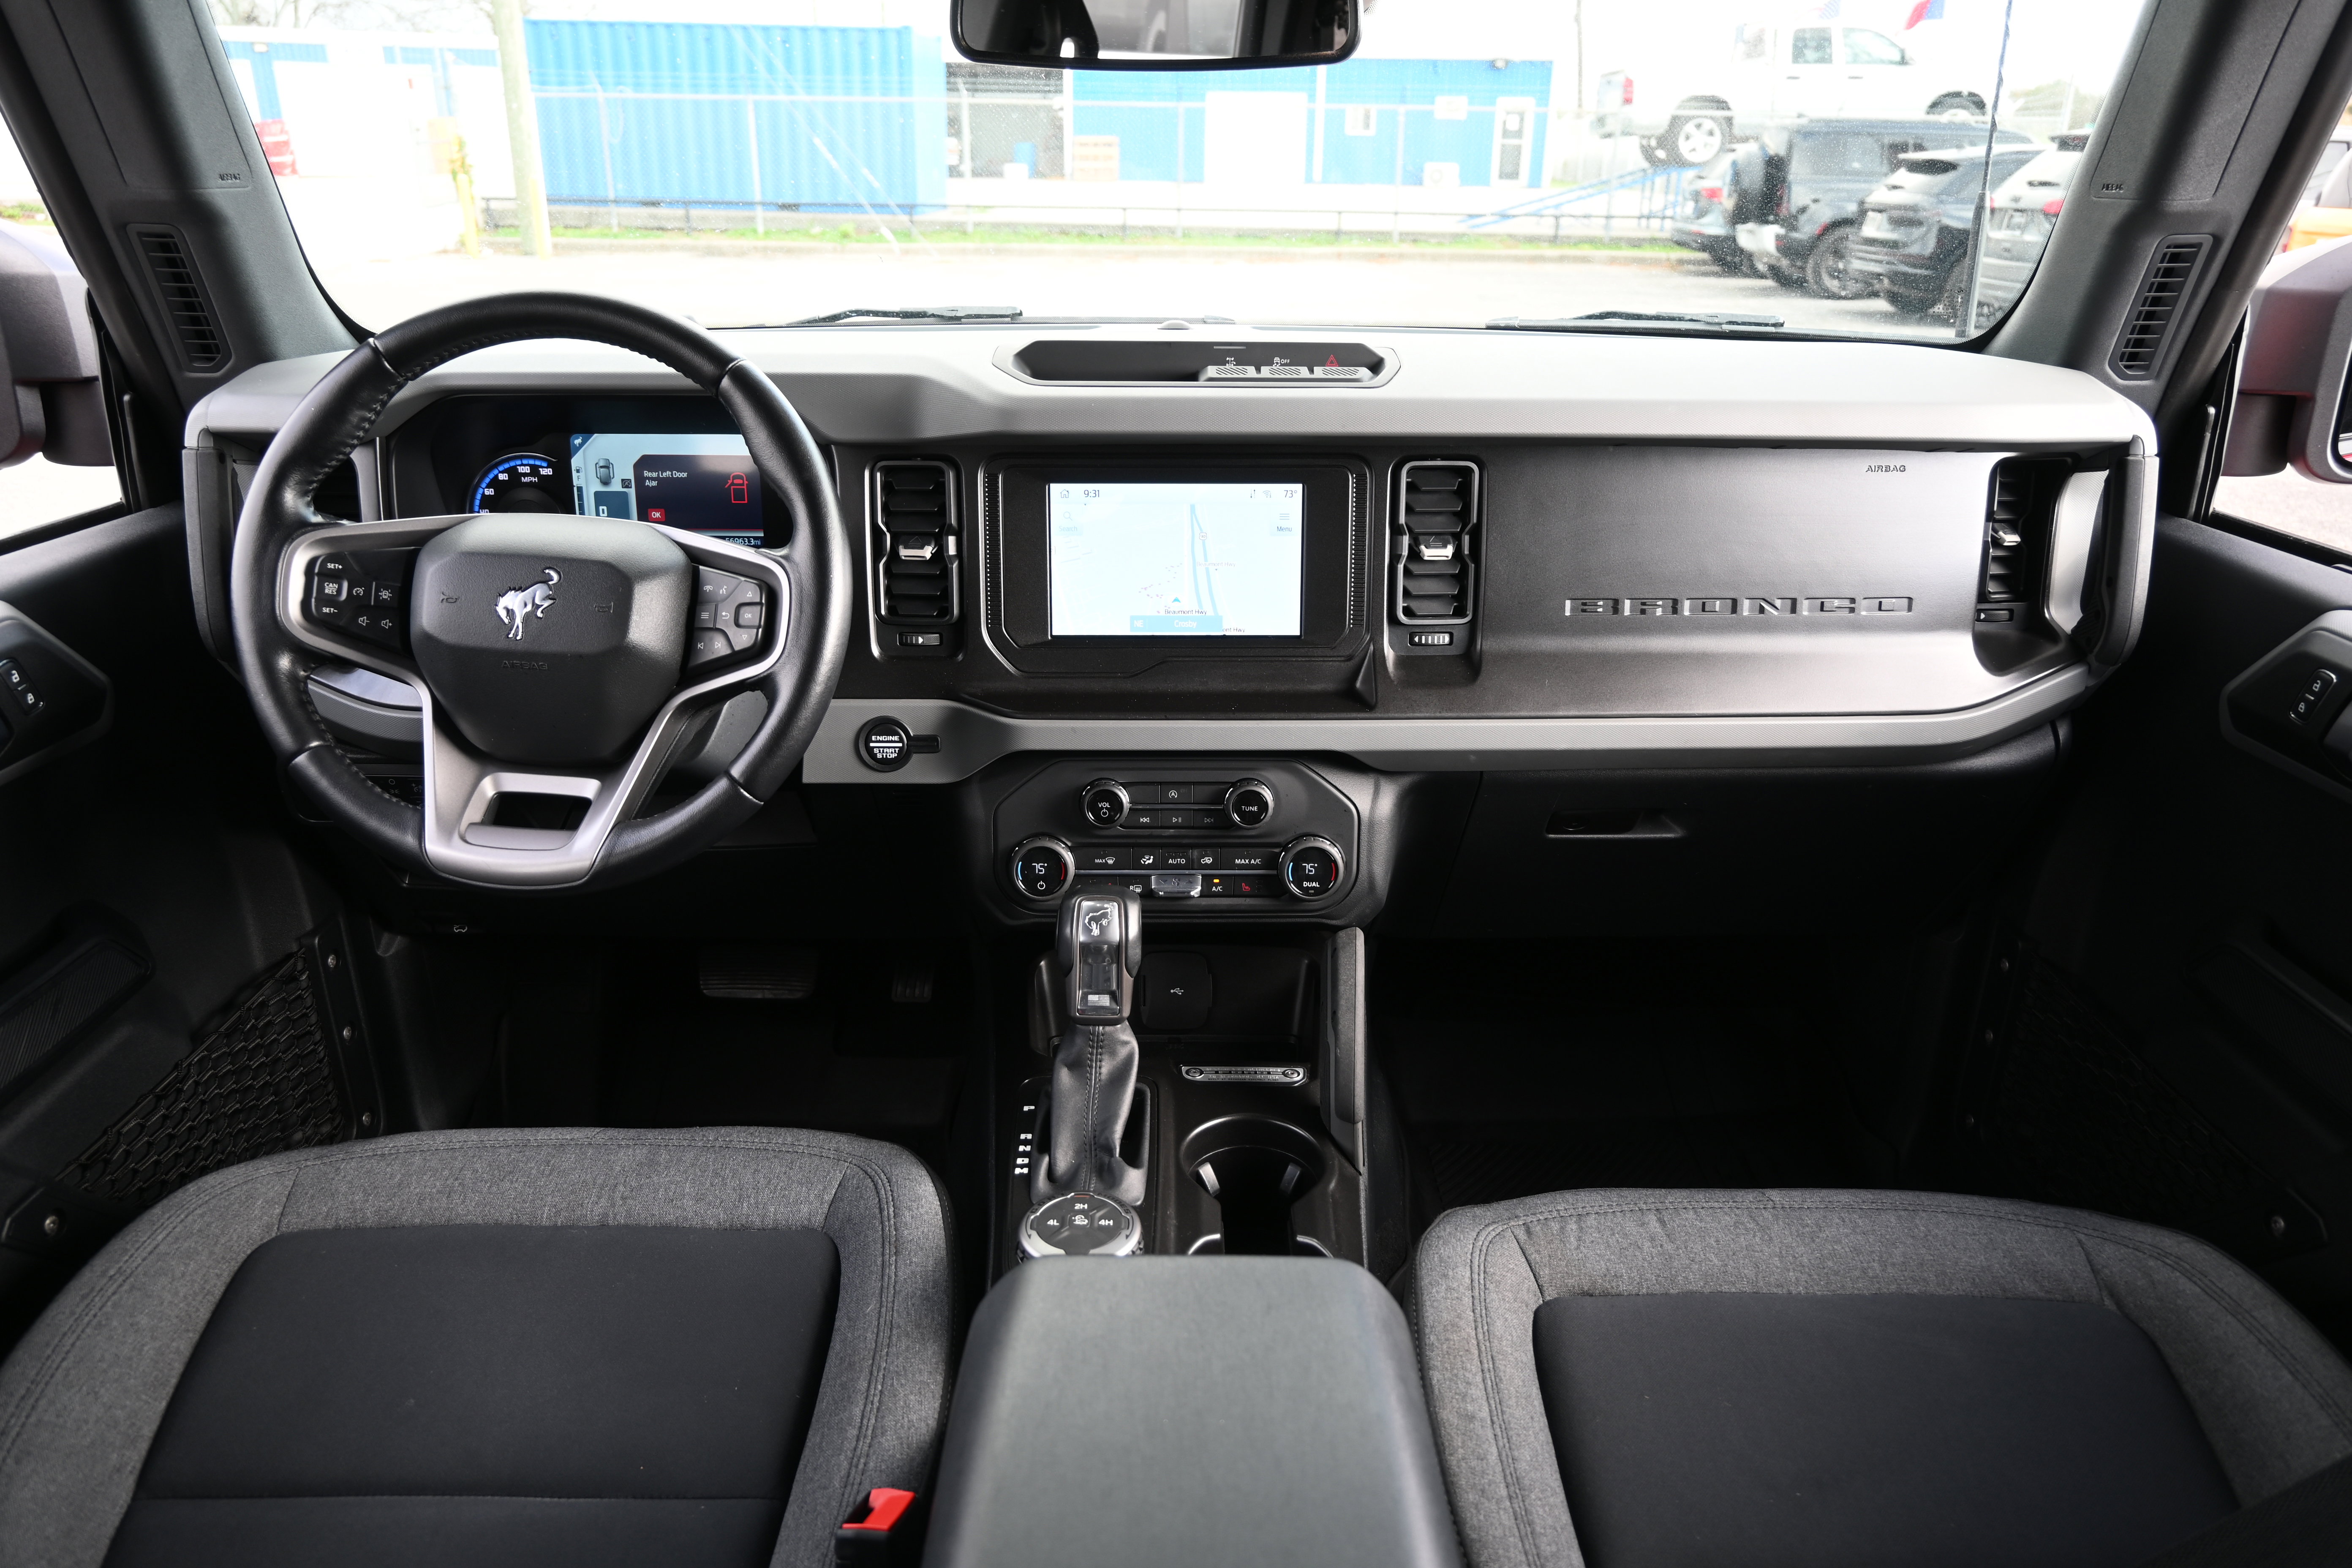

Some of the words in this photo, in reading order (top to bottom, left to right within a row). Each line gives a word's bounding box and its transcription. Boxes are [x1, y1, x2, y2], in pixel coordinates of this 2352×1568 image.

[218, 173, 240, 181] AIRBAG
[1084, 490, 1100, 498] 9:31
[599, 506, 607, 517] D
[1565, 596, 1914, 617] BRONCO
[1174, 620, 1197, 629] Crosby
[501, 660, 547, 670] AIRBAG
